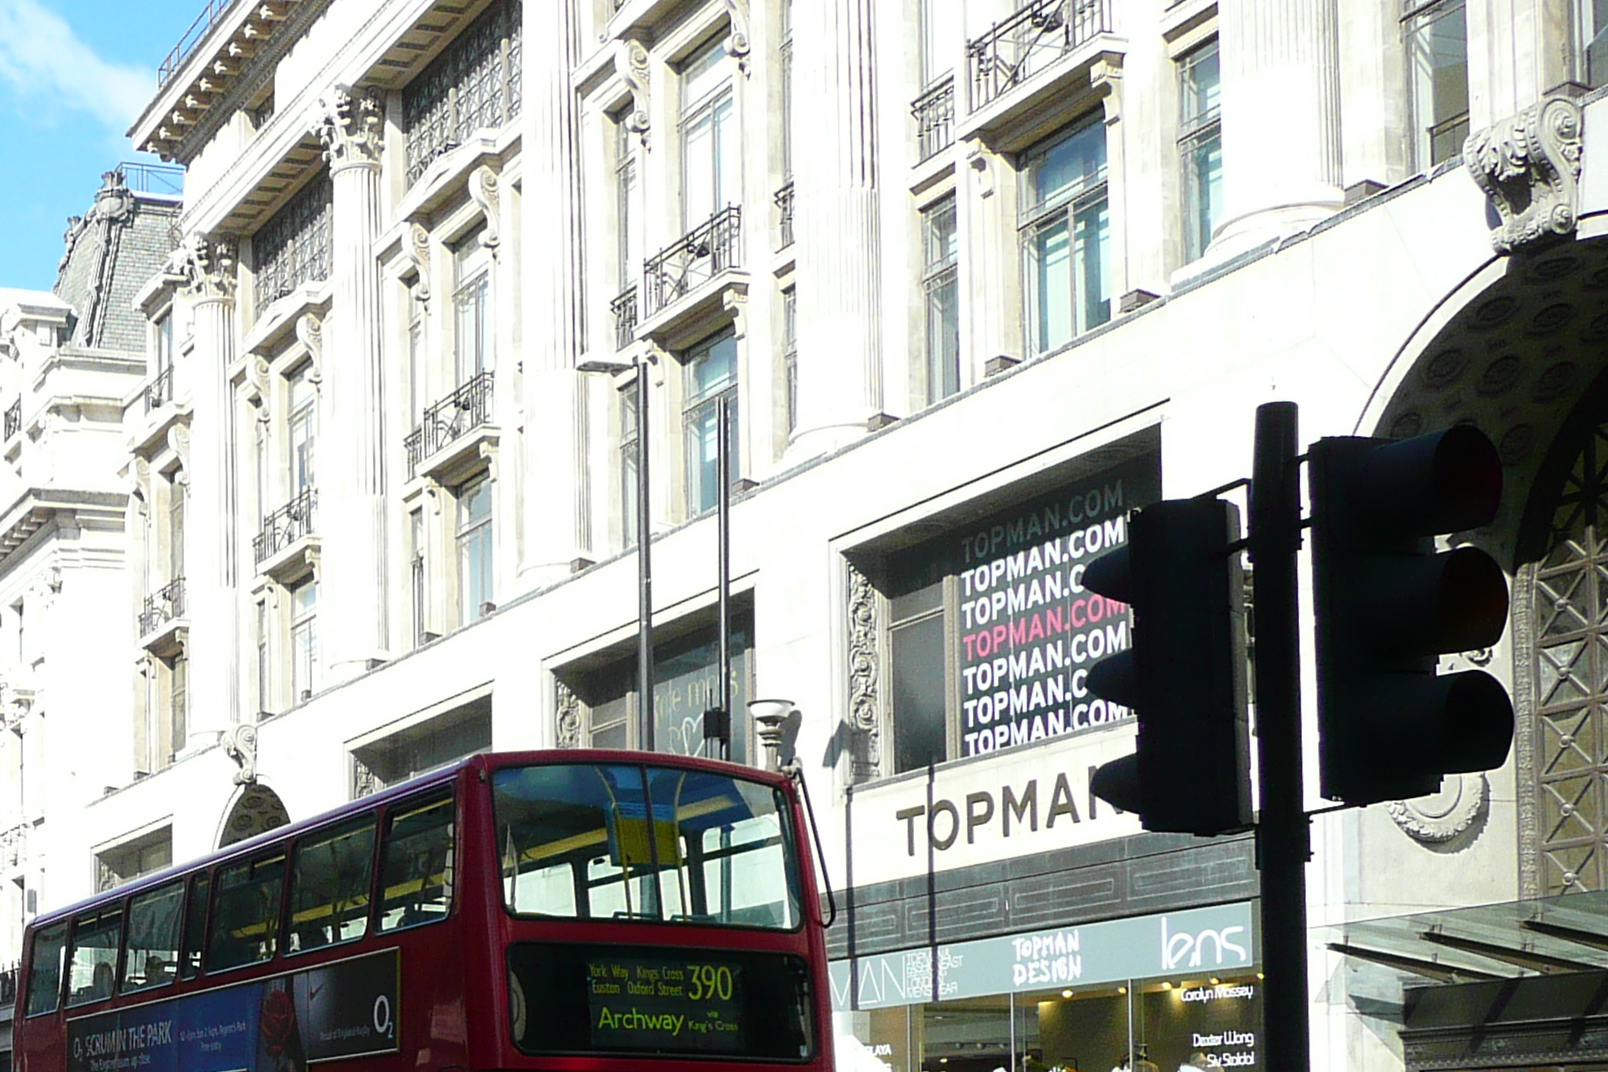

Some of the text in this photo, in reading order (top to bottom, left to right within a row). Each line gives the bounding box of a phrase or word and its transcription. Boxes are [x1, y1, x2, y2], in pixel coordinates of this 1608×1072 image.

[961, 478, 1123, 563] TOPMAN.COM
[961, 516, 1124, 597] TOPMAN.COM
[963, 621, 1126, 695] TOPMAN.COM
[1012, 929, 1079, 962] TOPMAN
[1160, 916, 1246, 970] lens
[589, 963, 684, 981] York Way Kings Cross
[687, 965, 733, 1000] 390
[1013, 955, 1082, 987] DESIGN
[592, 980, 683, 996] Euston Oxford Street
[1180, 985, 1254, 1004] Carolyn Massey
[374, 995, 393, 1039] O2
[598, 1006, 684, 1036] Archway
[715, 1021, 739, 1031] Cross
[128, 1024, 146, 1050] THE
[146, 1019, 172, 1047] PARK
[1223, 1030, 1254, 1047] Wong
